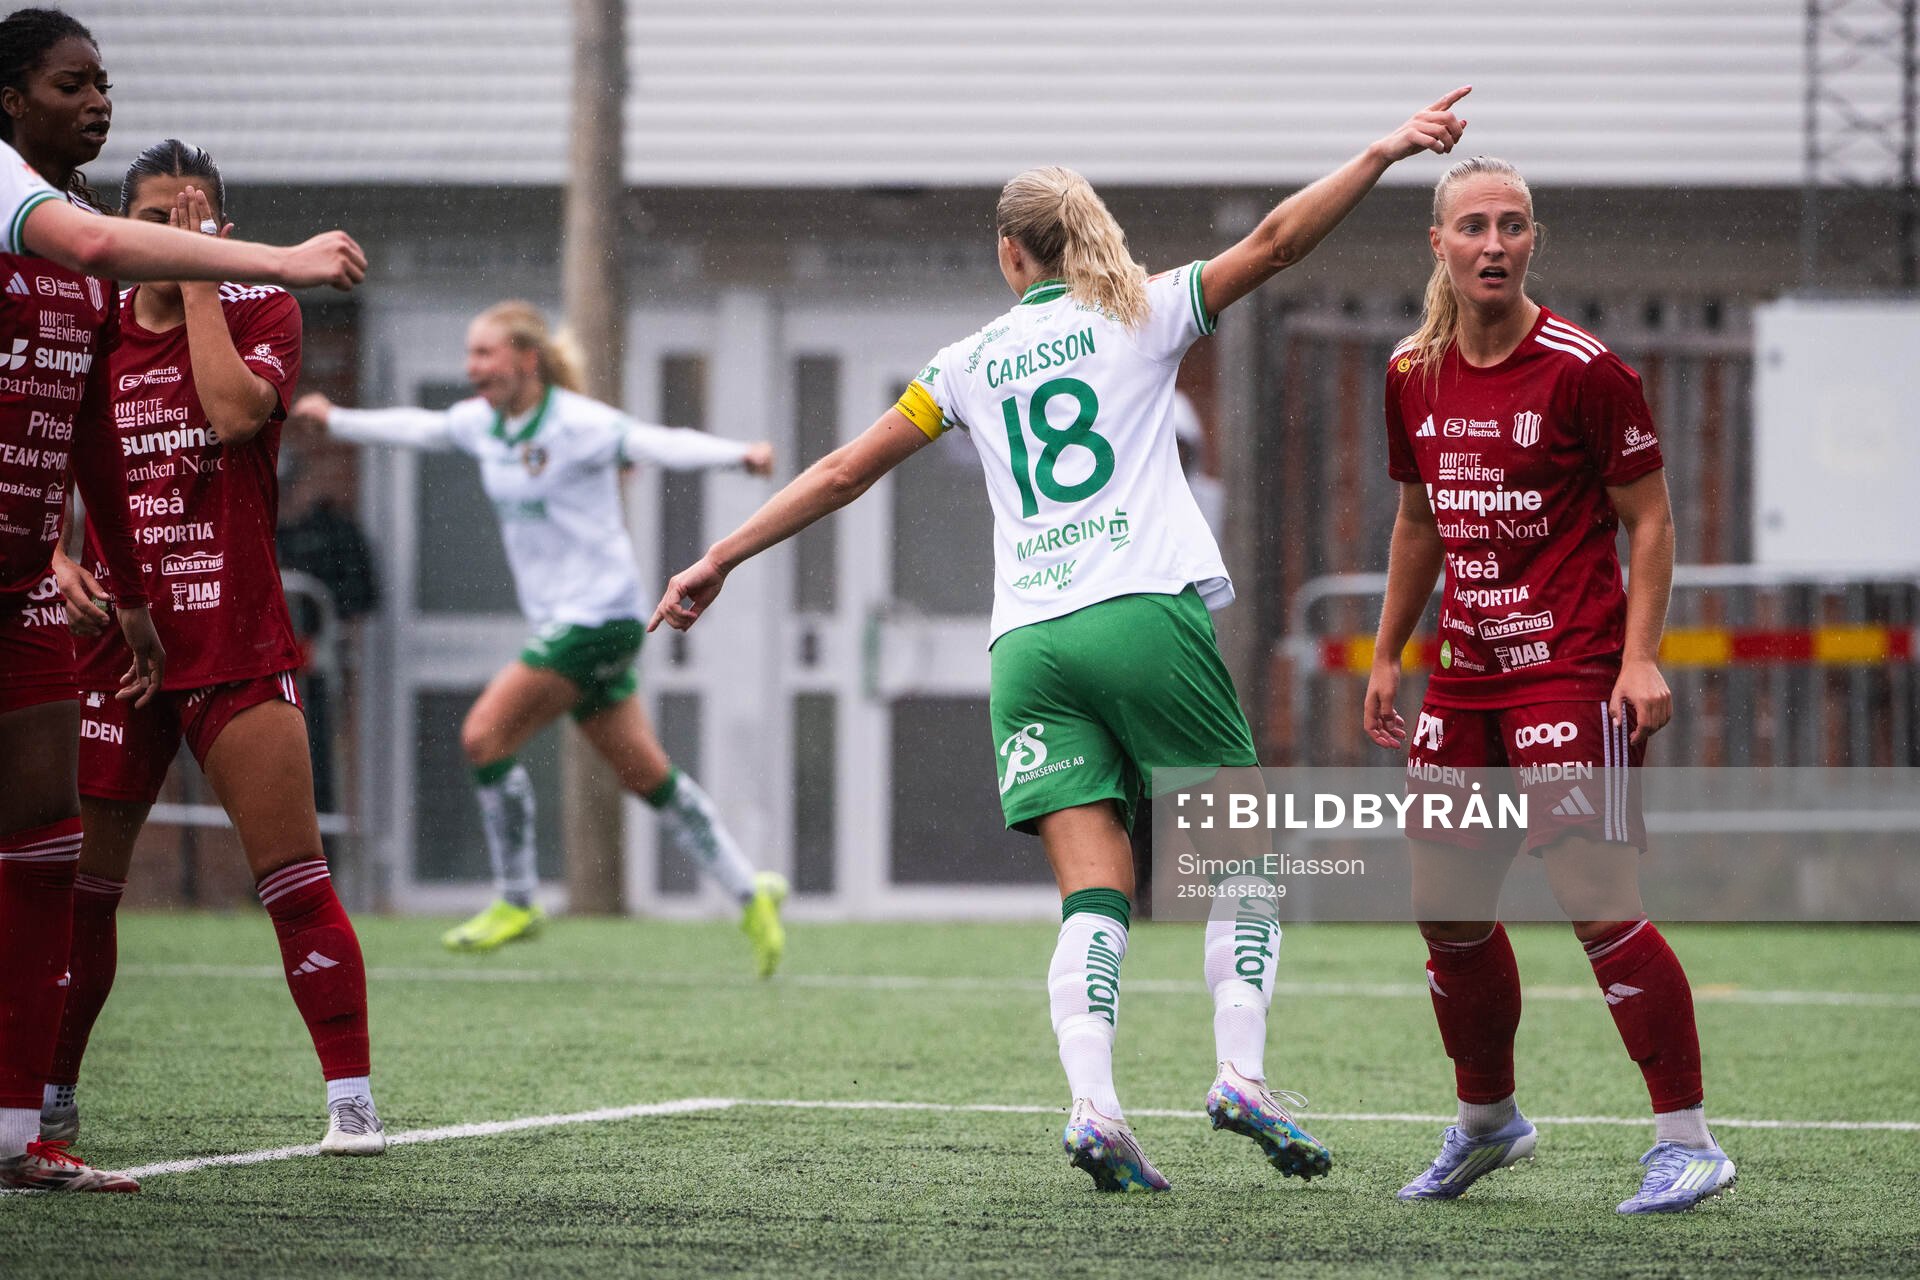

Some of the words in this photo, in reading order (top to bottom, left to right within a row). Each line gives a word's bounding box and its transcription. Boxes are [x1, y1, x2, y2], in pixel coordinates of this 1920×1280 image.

[56, 313, 76, 328] PITE
[56, 328, 92, 344] ENERGI
[34, 346, 93, 378] sunpin
[986, 327, 1096, 389] CARLSSON
[144, 374, 182, 385] Westrock
[136, 407, 189, 426] ENERGI
[137, 398, 163, 412] PITE
[27, 410, 73, 441] Piteå
[1467, 428, 1501, 438] Westrock
[1468, 419, 1499, 429] Smurfit
[1001, 377, 1116, 519] 18
[1457, 453, 1482, 467] PITE
[1457, 467, 1505, 482] ENERGI
[129, 488, 185, 518] Piteå
[1437, 484, 1543, 517] sunpine
[142, 521, 215, 545] SPORTIA
[1495, 517, 1550, 539] Nord
[1012, 559, 1077, 590] BANK
[186, 581, 221, 603] JIAB
[1484, 616, 1551, 637] ÄLVSBYHUS
[1508, 641, 1551, 666] JIAB
[80, 718, 124, 745] IDEN
[1515, 721, 1578, 749] coop
[1016, 759, 1072, 785] MARKSERVICE
[1073, 755, 1085, 767] AB
[1406, 757, 1466, 789] NÅIDEN
[1523, 760, 1593, 788] NÅIDEN
